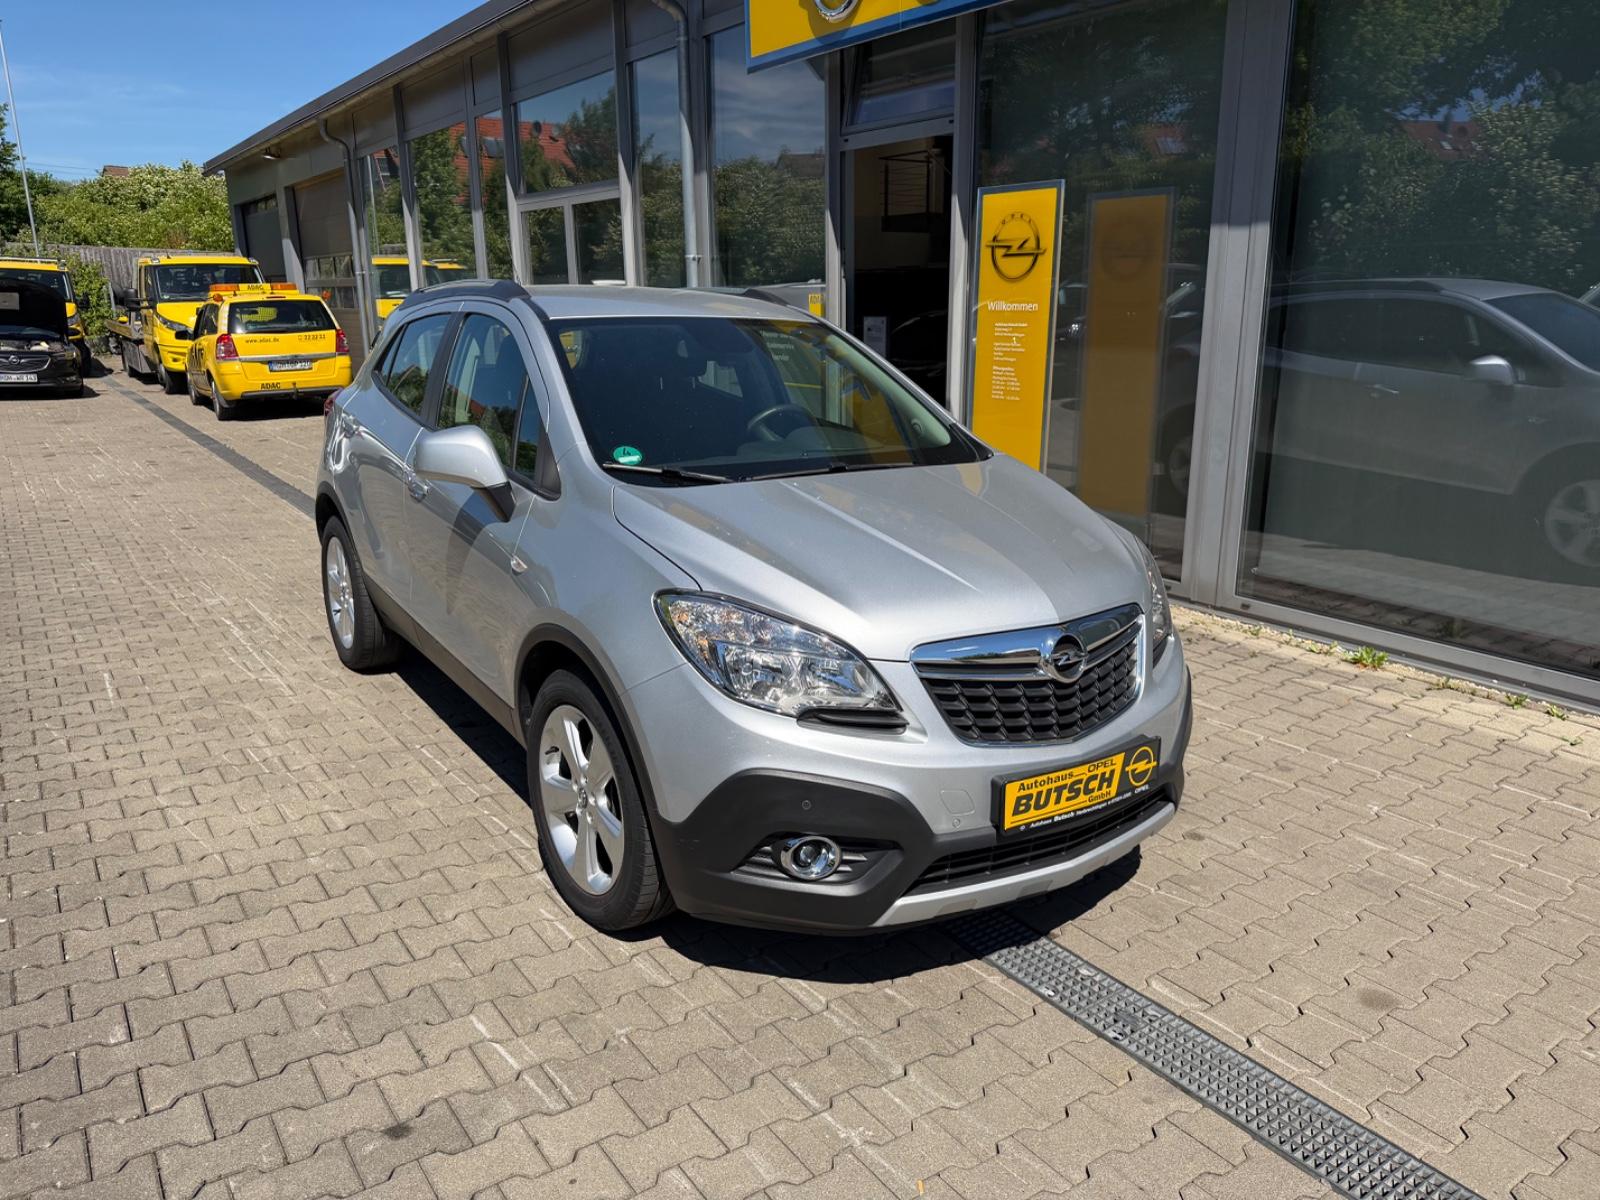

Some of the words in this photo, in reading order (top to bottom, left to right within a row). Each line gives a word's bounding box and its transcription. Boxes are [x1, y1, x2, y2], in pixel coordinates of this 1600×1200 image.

[987, 301, 1039, 311] Willkommen
[1017, 771, 1074, 793] Autohaus
[1087, 758, 1117, 773] OPEL
[1011, 769, 1115, 817] BUTSCH
[1087, 790, 1112, 804] GmbH
[1053, 811, 1076, 822] Butsch
